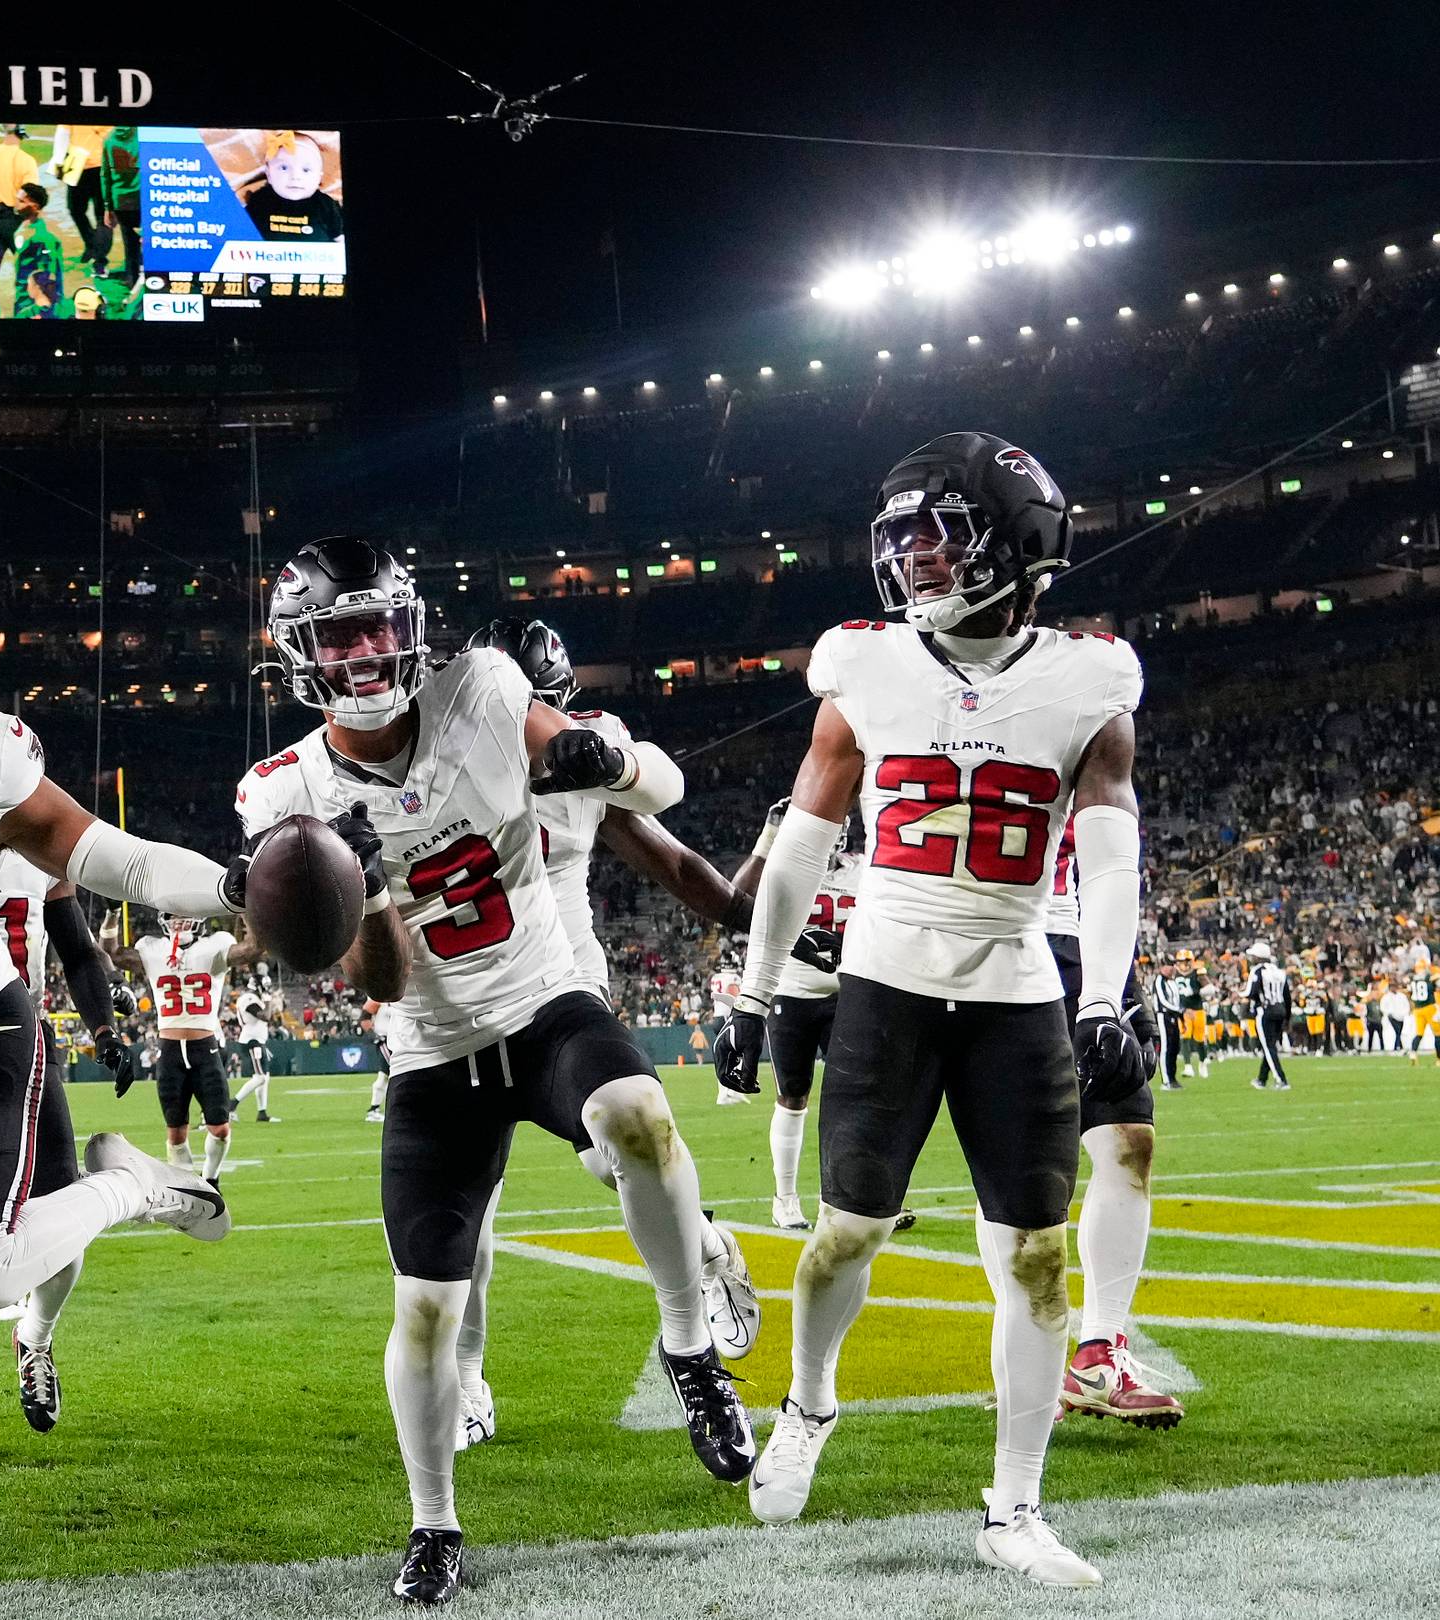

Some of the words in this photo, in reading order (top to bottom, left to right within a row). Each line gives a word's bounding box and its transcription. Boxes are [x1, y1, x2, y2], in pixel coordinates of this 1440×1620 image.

[148, 158, 201, 172] Official
[149, 173, 221, 188] Children's
[149, 189, 210, 204] Hospital
[150, 205, 167, 217] of
[168, 206, 194, 218] the
[150, 220, 195, 234] Green
[197, 221, 226, 236] Bay
[151, 236, 213, 250] Packers.
[254, 250, 303, 262] Health
[348, 592, 376, 603] ATL
[929, 740, 1006, 755] ATLANTA
[870, 754, 1061, 886] 26
[402, 817, 472, 862] ATLANTA
[406, 832, 516, 962] 3
[156, 972, 212, 1017] 33
